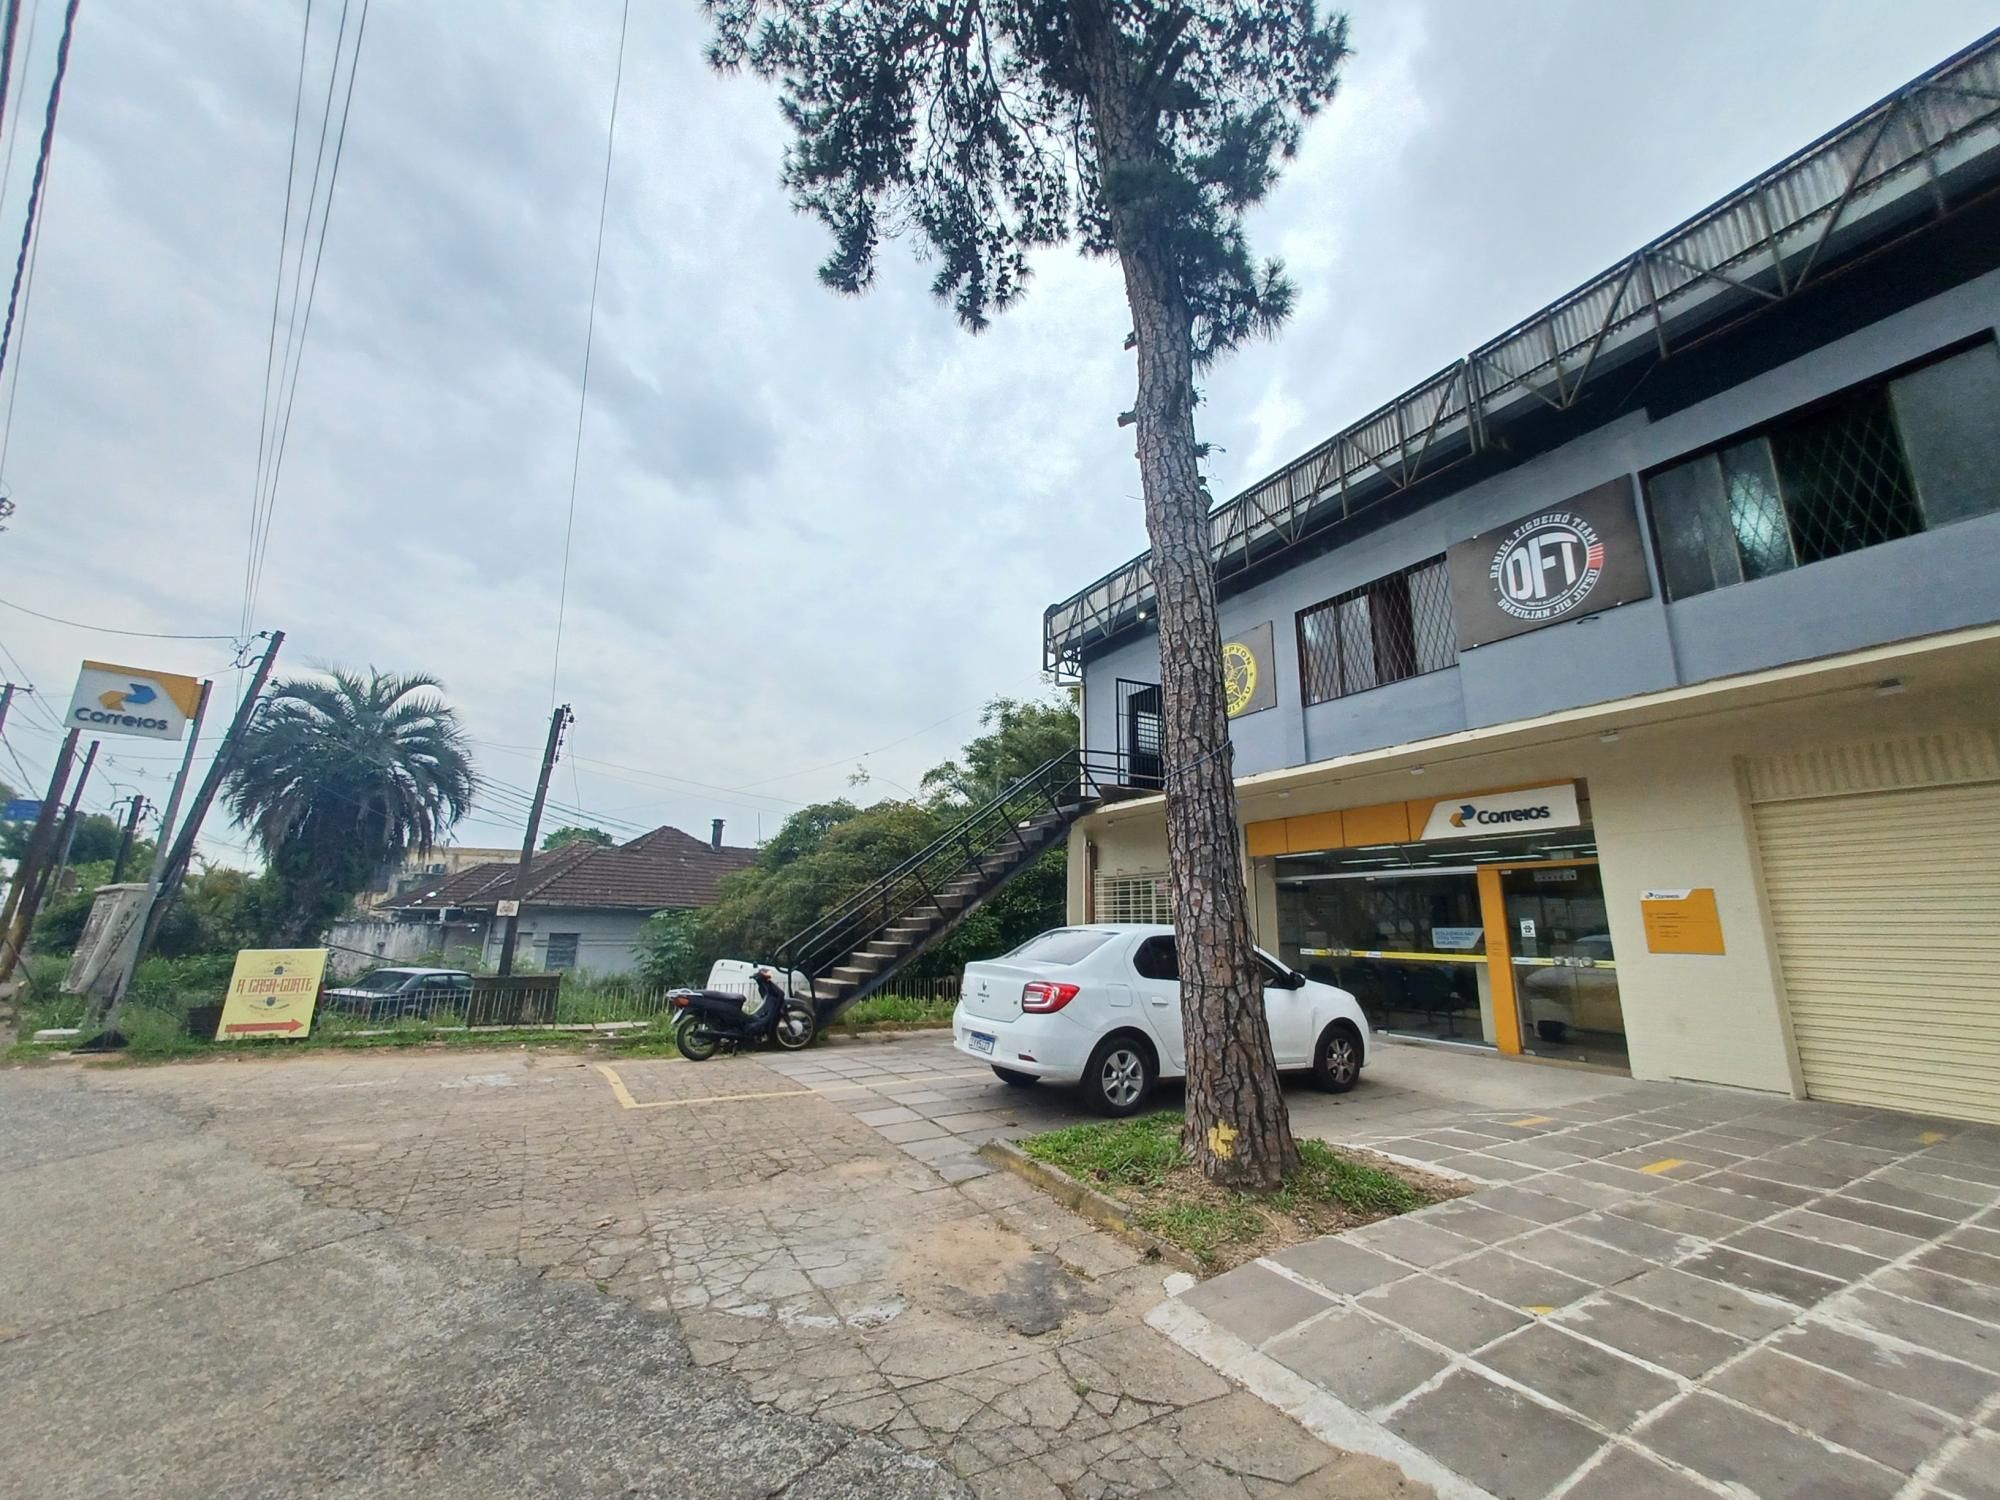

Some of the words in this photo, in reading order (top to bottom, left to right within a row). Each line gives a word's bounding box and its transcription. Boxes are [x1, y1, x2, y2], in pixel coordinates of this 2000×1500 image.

[1489, 539, 1513, 579] DANIEL
[1571, 517, 1598, 545] TEAM
[1506, 532, 1578, 600] DFT
[1497, 598, 1550, 619] BRAZILIAN
[1553, 599, 1572, 614] JIU
[1574, 568, 1599, 601] JITSU
[1223, 646, 1252, 665] RPYON
[75, 707, 168, 730] Correios
[1477, 806, 1550, 825] Correios
